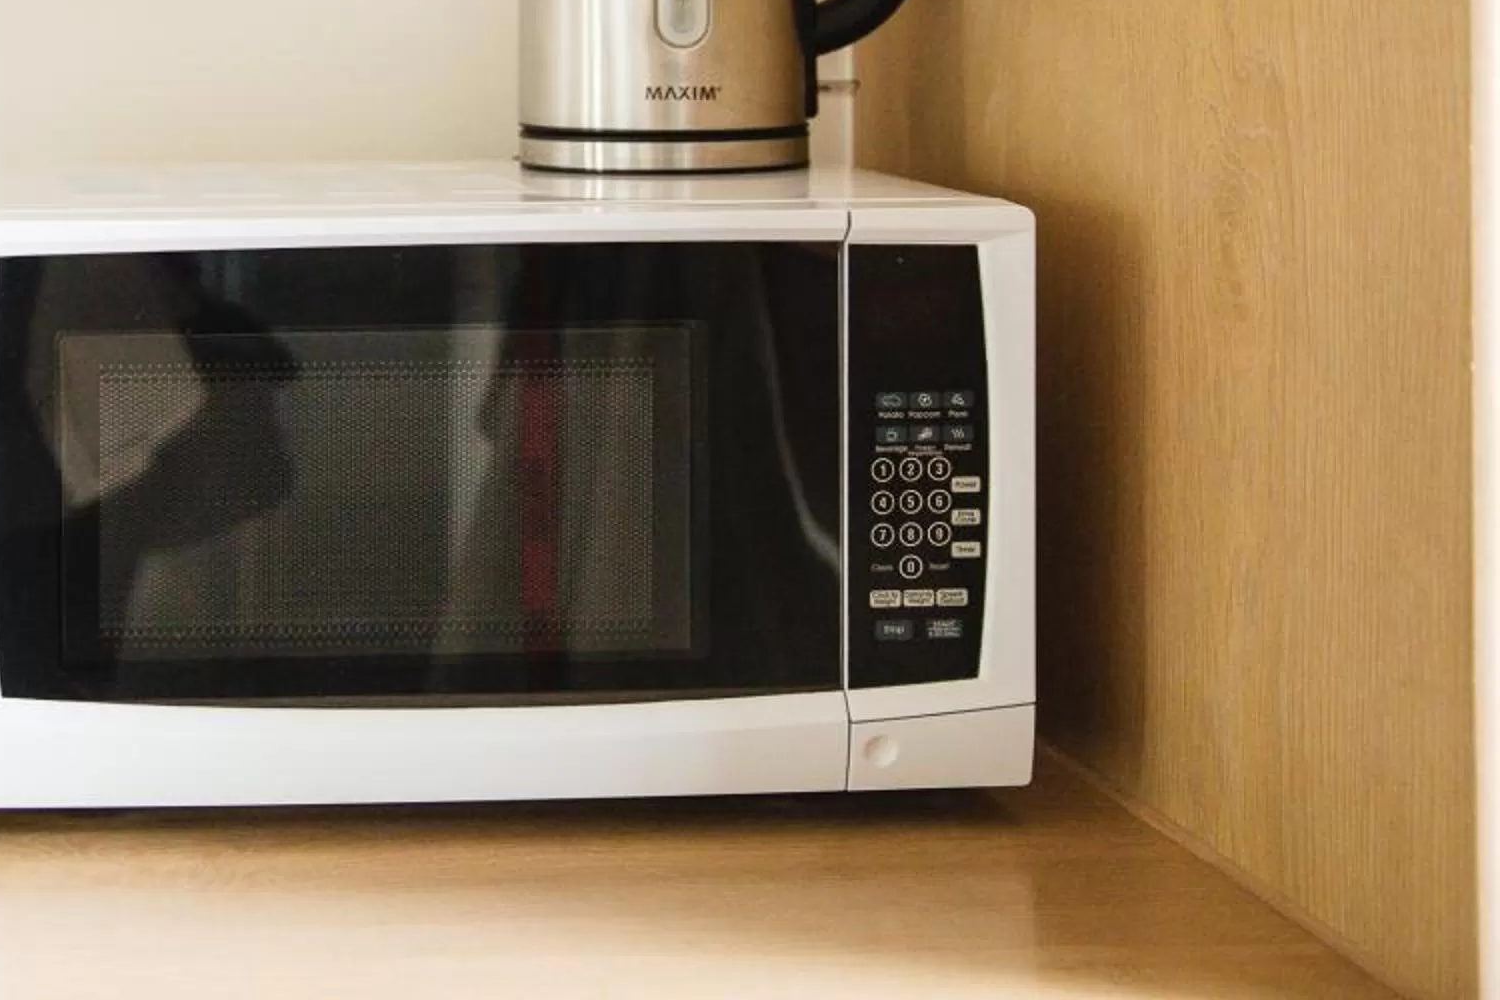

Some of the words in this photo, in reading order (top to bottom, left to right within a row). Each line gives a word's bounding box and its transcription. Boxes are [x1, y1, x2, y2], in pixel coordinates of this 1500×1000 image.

[907, 463, 915, 476] 2
[935, 463, 943, 475] 3
[879, 497, 887, 509] 4
[907, 496, 915, 508] 5
[935, 495, 943, 507] 6
[879, 529, 887, 541] 7
[907, 528, 915, 540] 8
[935, 528, 943, 540] 9
[907, 561, 915, 573] 0
